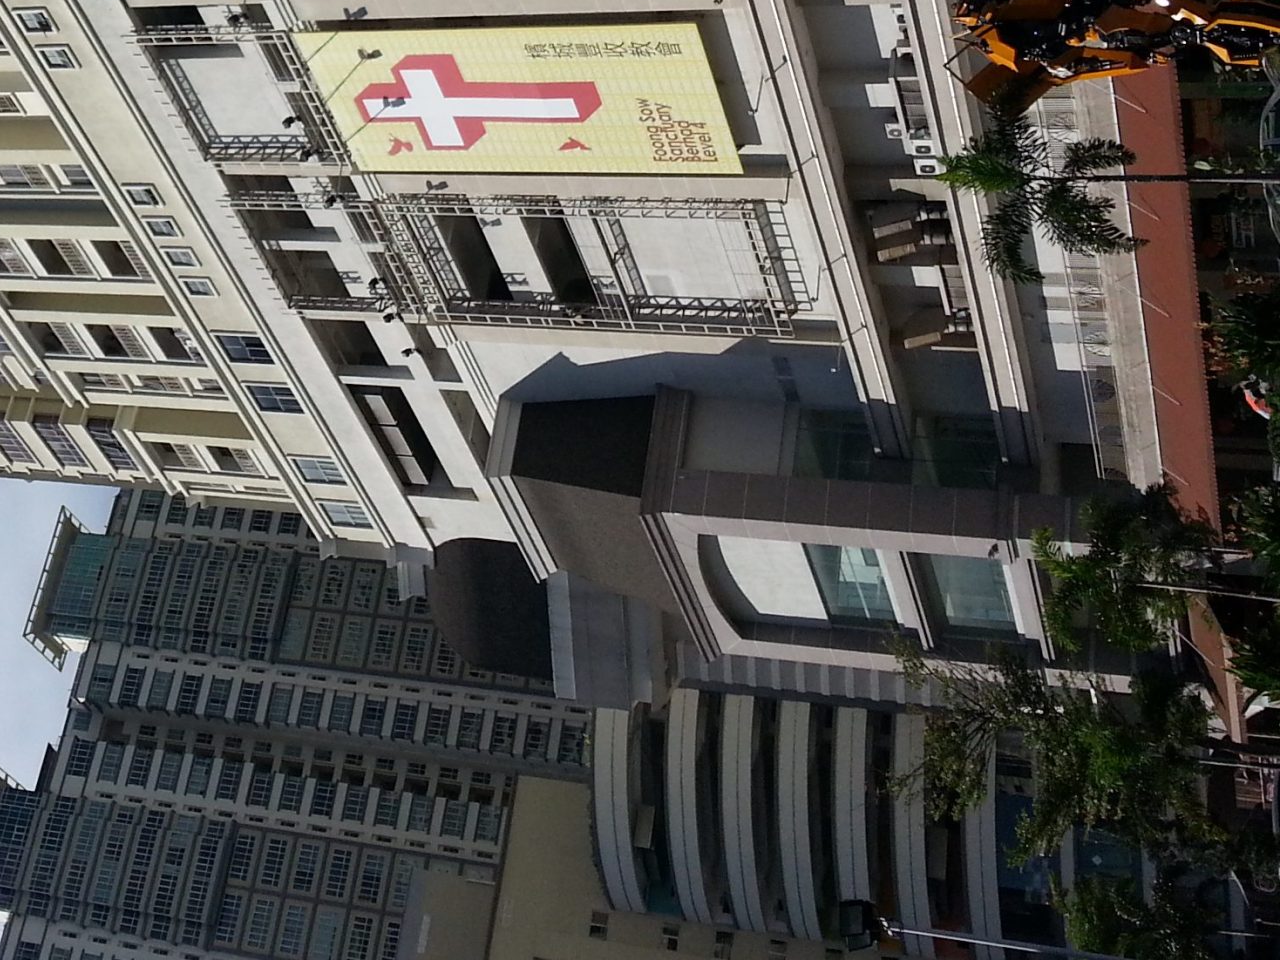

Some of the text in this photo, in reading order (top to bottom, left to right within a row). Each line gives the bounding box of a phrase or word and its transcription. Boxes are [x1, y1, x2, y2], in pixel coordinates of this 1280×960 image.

[635, 97, 669, 162] Foong Sow
[654, 102, 686, 162] Sanctuary
[672, 120, 702, 162] Berhad
[689, 121, 718, 162] Level 4
